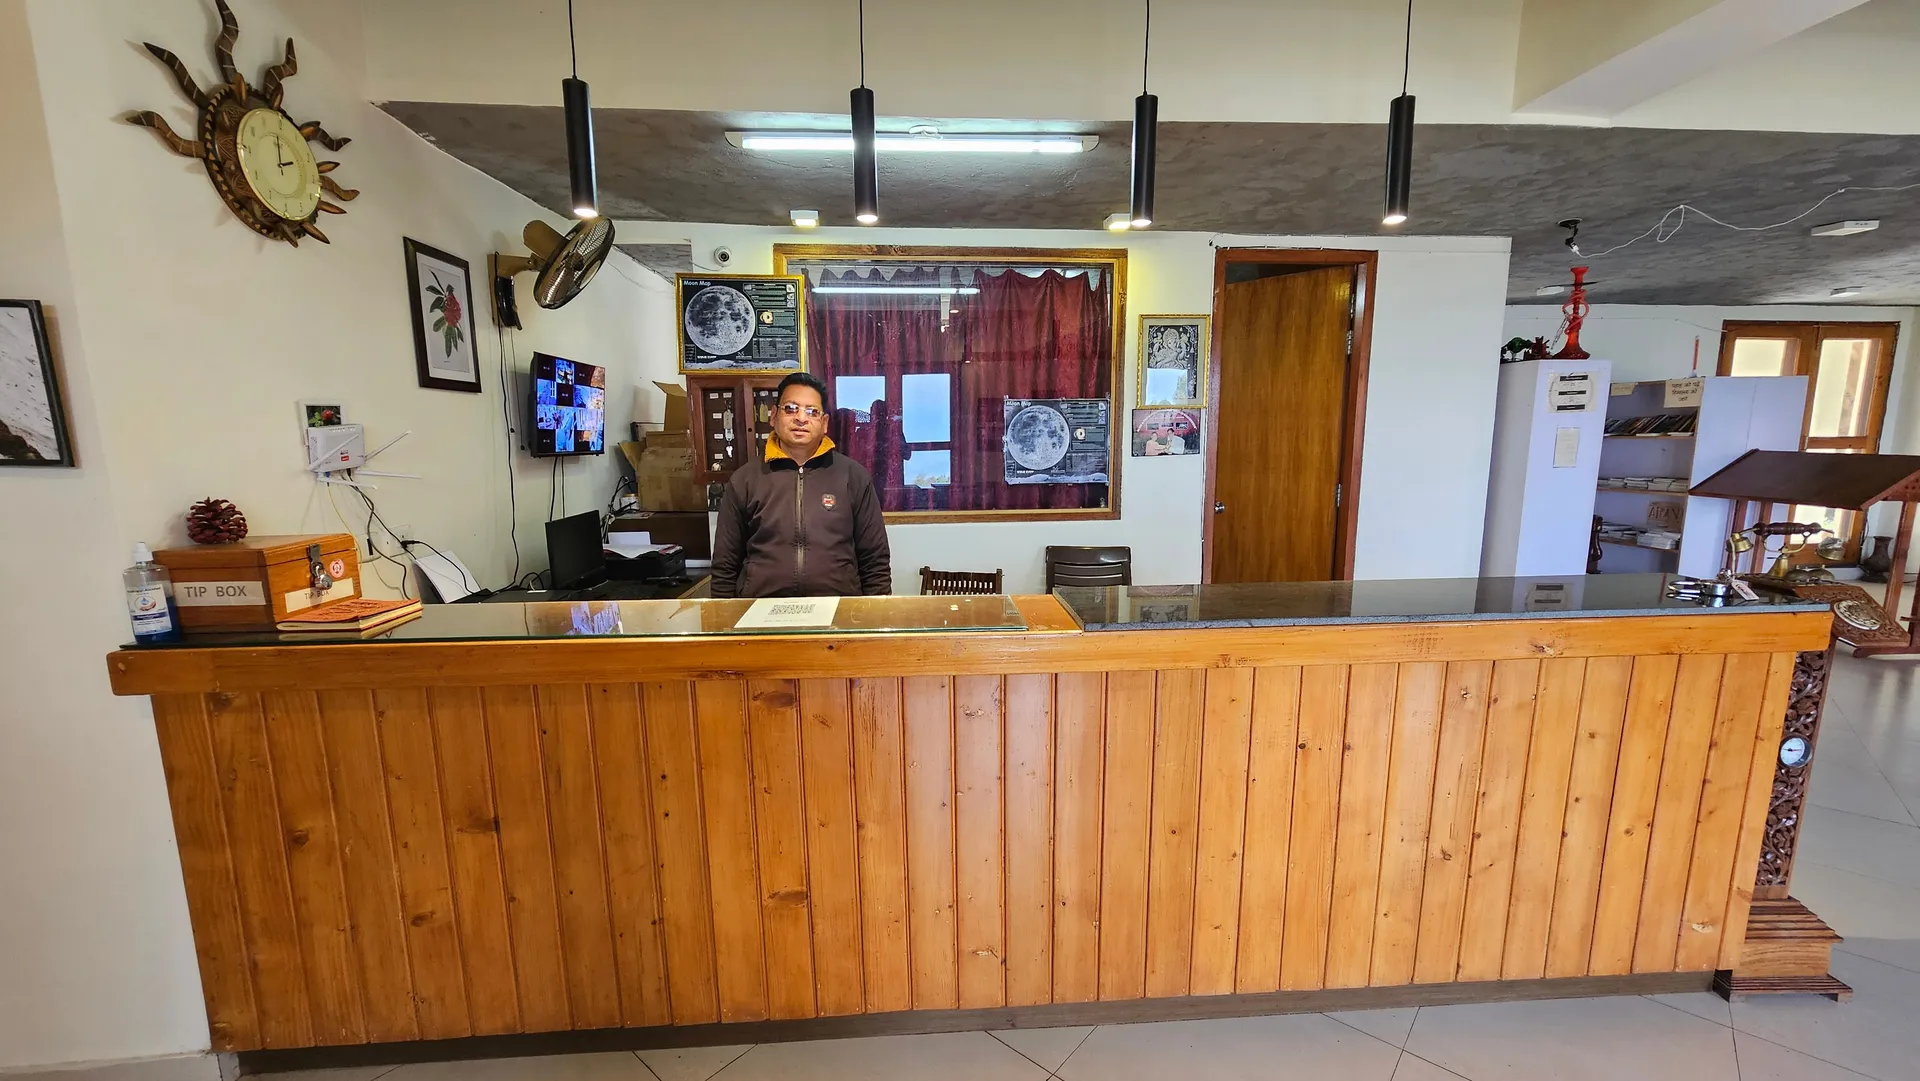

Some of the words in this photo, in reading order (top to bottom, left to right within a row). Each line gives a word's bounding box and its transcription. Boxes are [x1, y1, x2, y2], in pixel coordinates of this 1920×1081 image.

[183, 586, 207, 598] TIP
[215, 585, 247, 597] BOX
[304, 591, 314, 600] TIP
[316, 590, 331, 598] BOX
